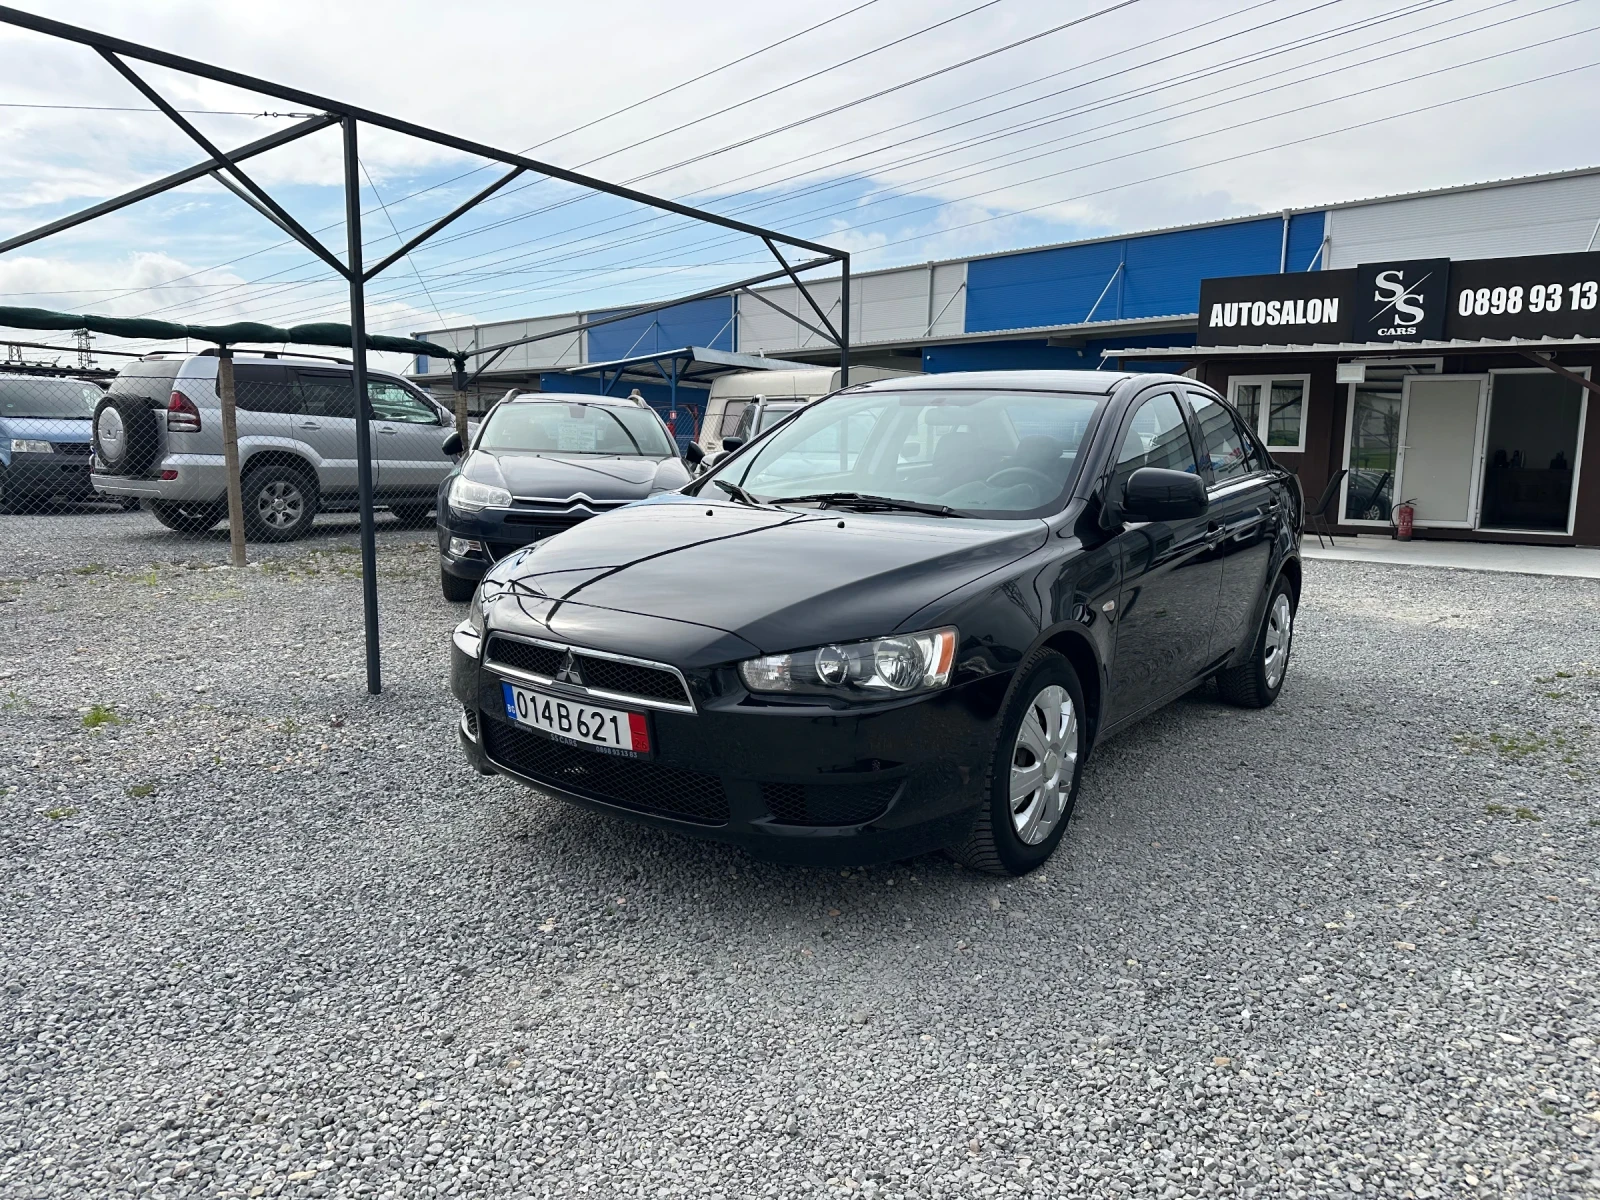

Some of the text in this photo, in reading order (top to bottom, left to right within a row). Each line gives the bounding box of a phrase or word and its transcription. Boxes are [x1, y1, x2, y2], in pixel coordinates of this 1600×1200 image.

[1208, 297, 1339, 328] AUTOSALON
[1458, 281, 1599, 317] 0898 93 13
[1377, 326, 1417, 336] CARS
[507, 703, 516, 714] BG
[516, 690, 621, 745] 014B621
